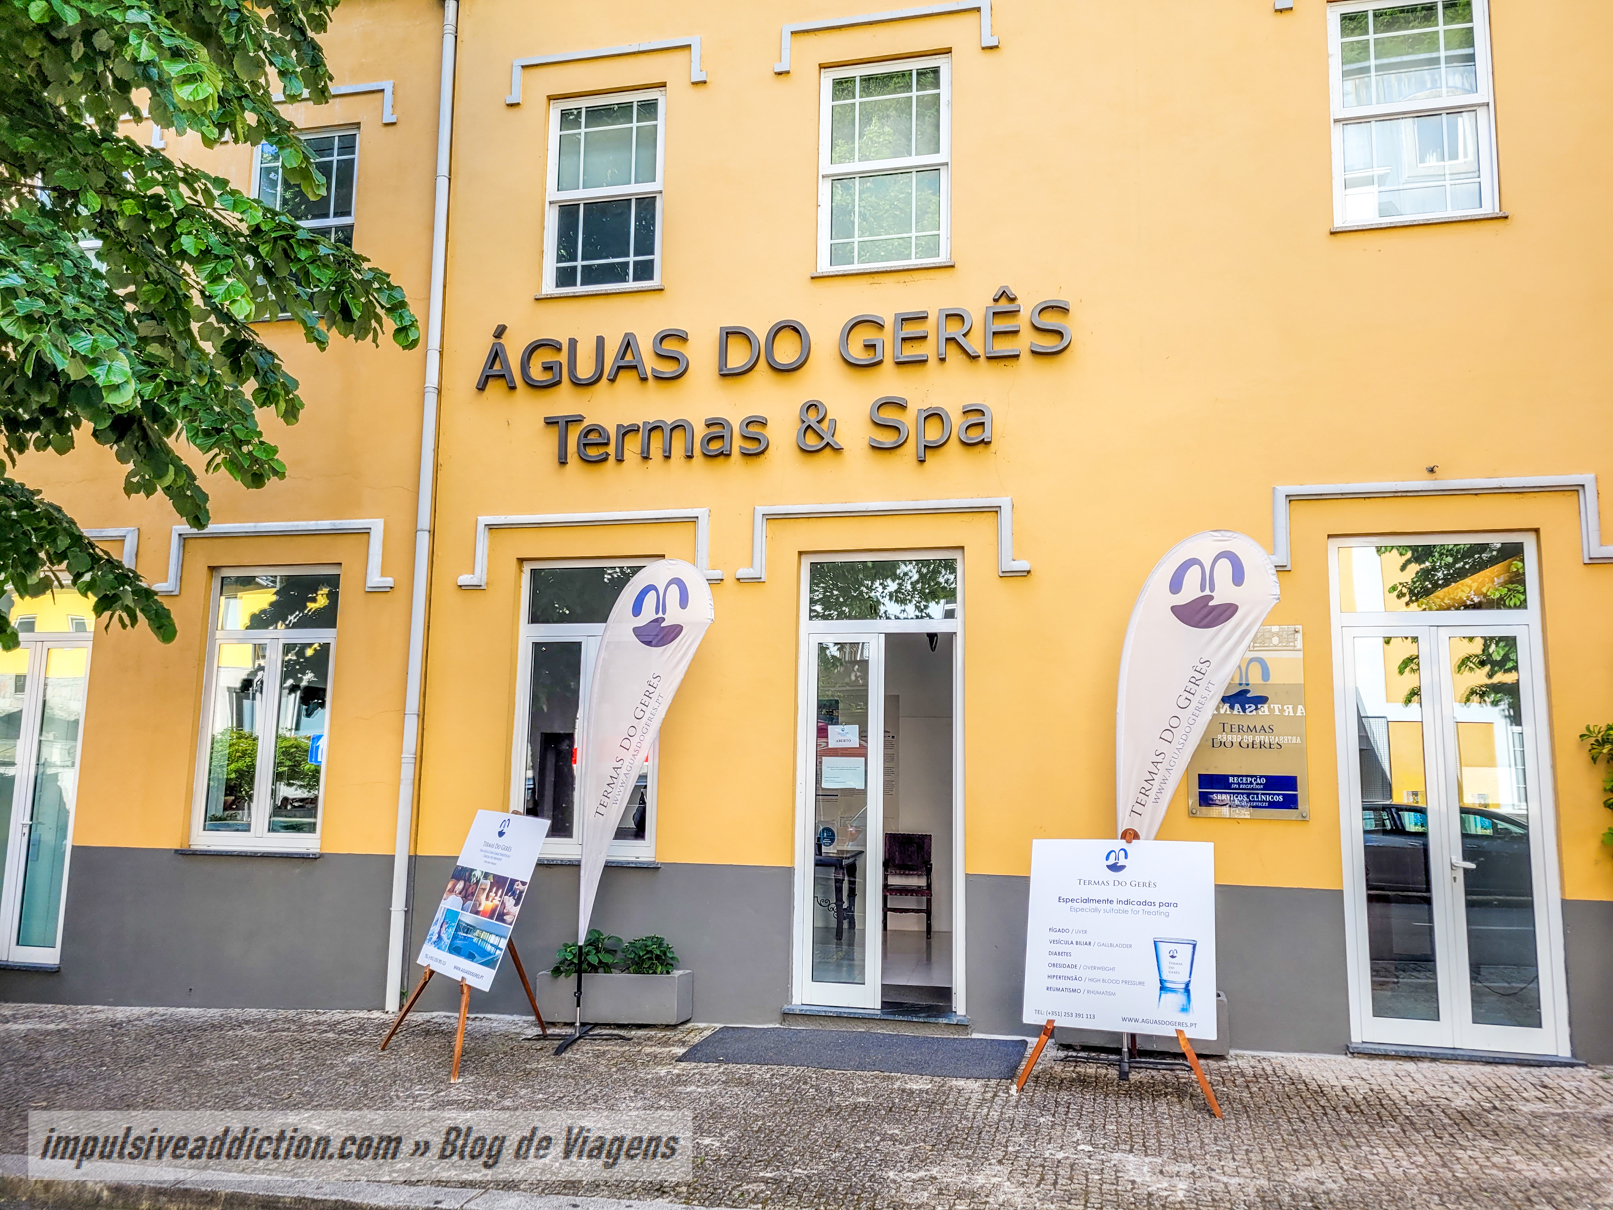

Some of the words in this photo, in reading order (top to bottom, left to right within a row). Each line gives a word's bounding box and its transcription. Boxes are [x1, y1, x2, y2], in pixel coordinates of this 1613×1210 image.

[475, 323, 690, 391] ÁGUAS
[718, 319, 811, 377] DO
[838, 285, 1072, 367] GERÊS
[543, 413, 769, 464] Termas
[796, 399, 844, 453] &
[869, 395, 993, 462] Spa
[1218, 722, 1274, 734] TERMAS
[1128, 749, 1167, 818] TERMAS
[1175, 656, 1212, 710] GERÊS
[593, 755, 624, 819] TERMAS
[633, 672, 662, 720] GERÊS
[1229, 776, 1266, 785] RECEPÇÃO
[1250, 793, 1283, 802] CLÍNICOS
[1077, 878, 1110, 887] TERMAS
[1057, 896, 1114, 906] Especialmente
[1116, 897, 1156, 907] indicadas
[1158, 900, 1179, 909] para
[1069, 906, 1102, 915] Especially
[1102, 907, 1129, 915] suitable
[1141, 908, 1170, 918] Treating
[1097, 941, 1133, 949] GALLBLADDER
[1047, 962, 1078, 970] OBESIDADE
[1082, 964, 1116, 972] OVERWEIGHT
[1047, 974, 1083, 982] HIPERTENSÃO
[1121, 979, 1146, 987] PRESSURE
[1046, 986, 1082, 994] REUMATISMO
[1046, 1010, 1063, 1018] (+351)
[1121, 1016, 1198, 1029] WWW.AGUASDOGERES.PT
